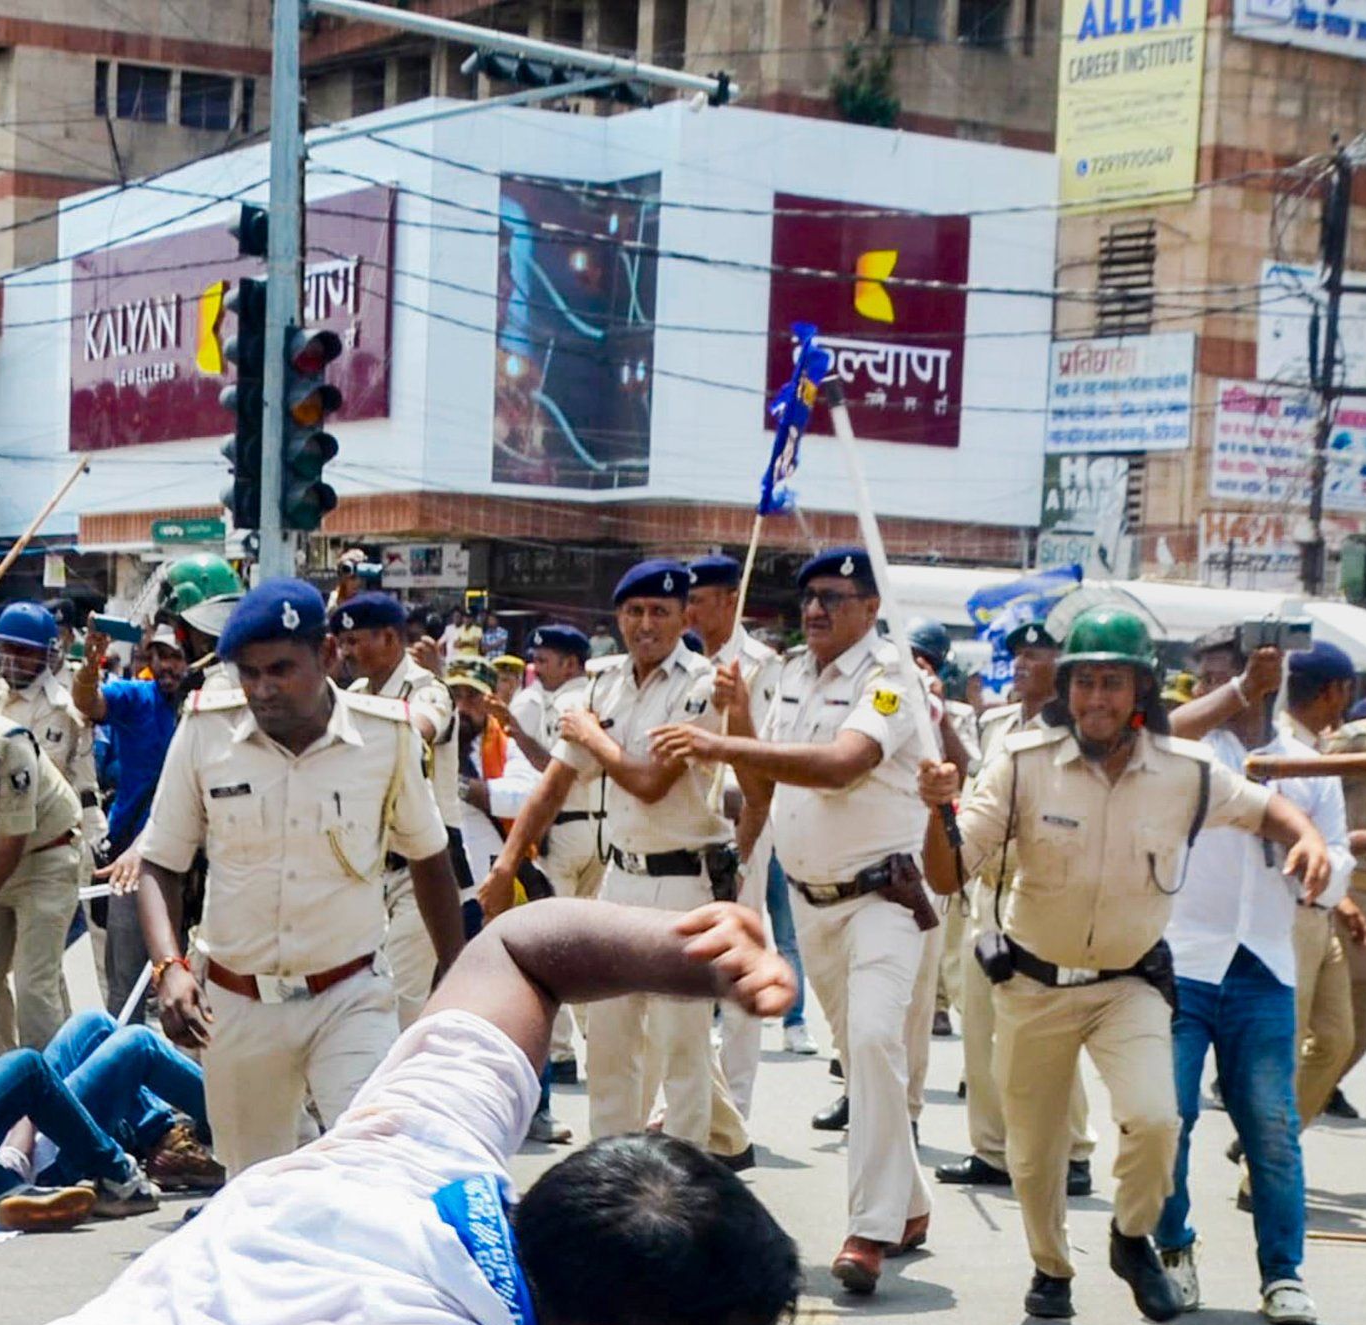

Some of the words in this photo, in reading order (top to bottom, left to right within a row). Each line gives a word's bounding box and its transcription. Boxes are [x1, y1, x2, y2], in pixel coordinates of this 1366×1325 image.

[1068, 51, 1119, 84] CAREER
[1123, 36, 1194, 73] INSTITUTE
[84, 292, 179, 362] KALYAN
